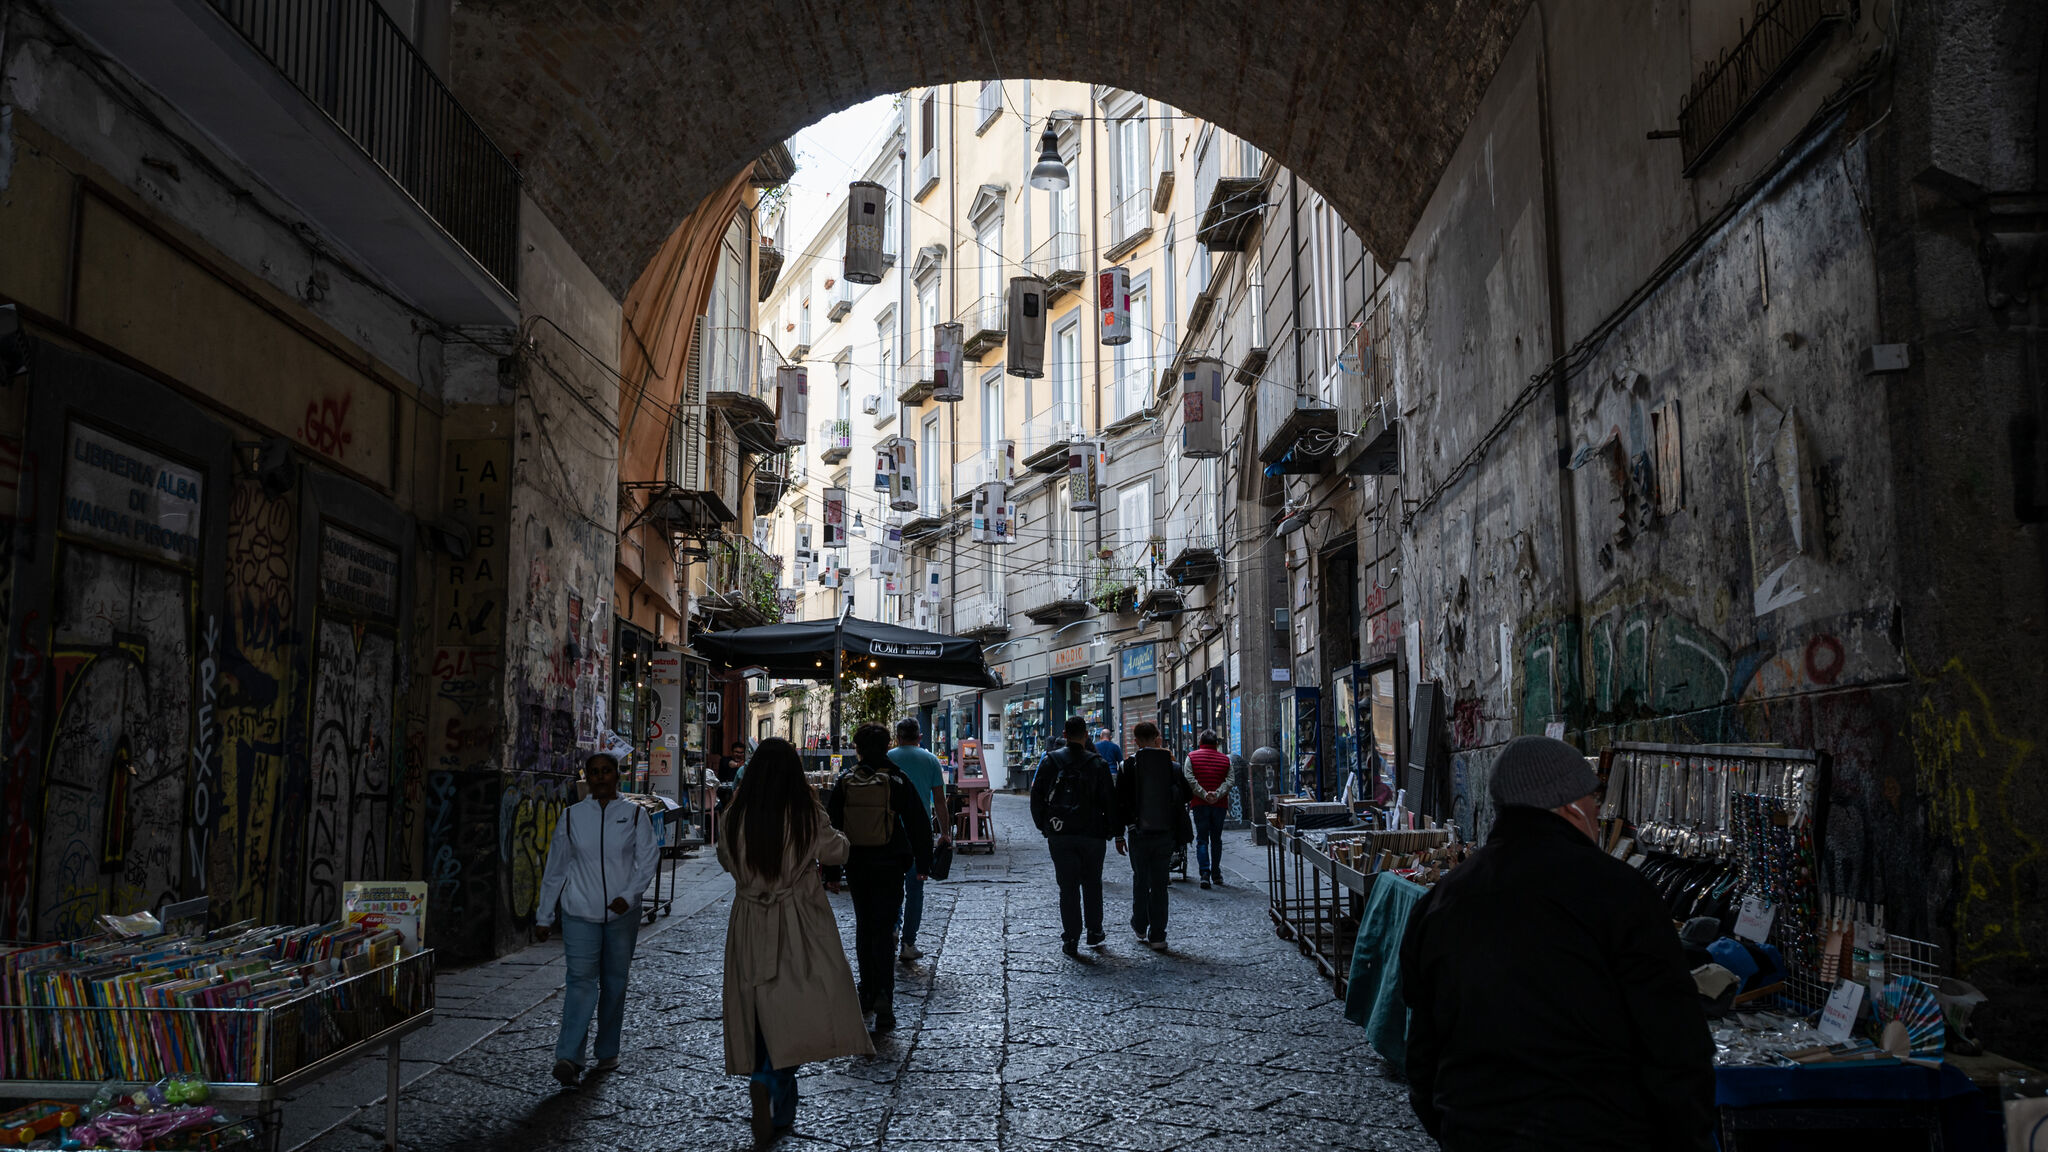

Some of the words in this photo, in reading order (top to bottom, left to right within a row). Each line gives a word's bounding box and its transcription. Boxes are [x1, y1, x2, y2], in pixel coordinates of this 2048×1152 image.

[75, 438, 154, 487] LIBRERIA
[157, 471, 198, 504] ALBA
[65, 496, 131, 537] WANDA
[129, 488, 149, 514] DI
[476, 460, 498, 582] ALBA
[448, 453, 469, 631] LIBRIA
[1056, 647, 1083, 664] AMODIO
[363, 902, 408, 912] IMPARO
